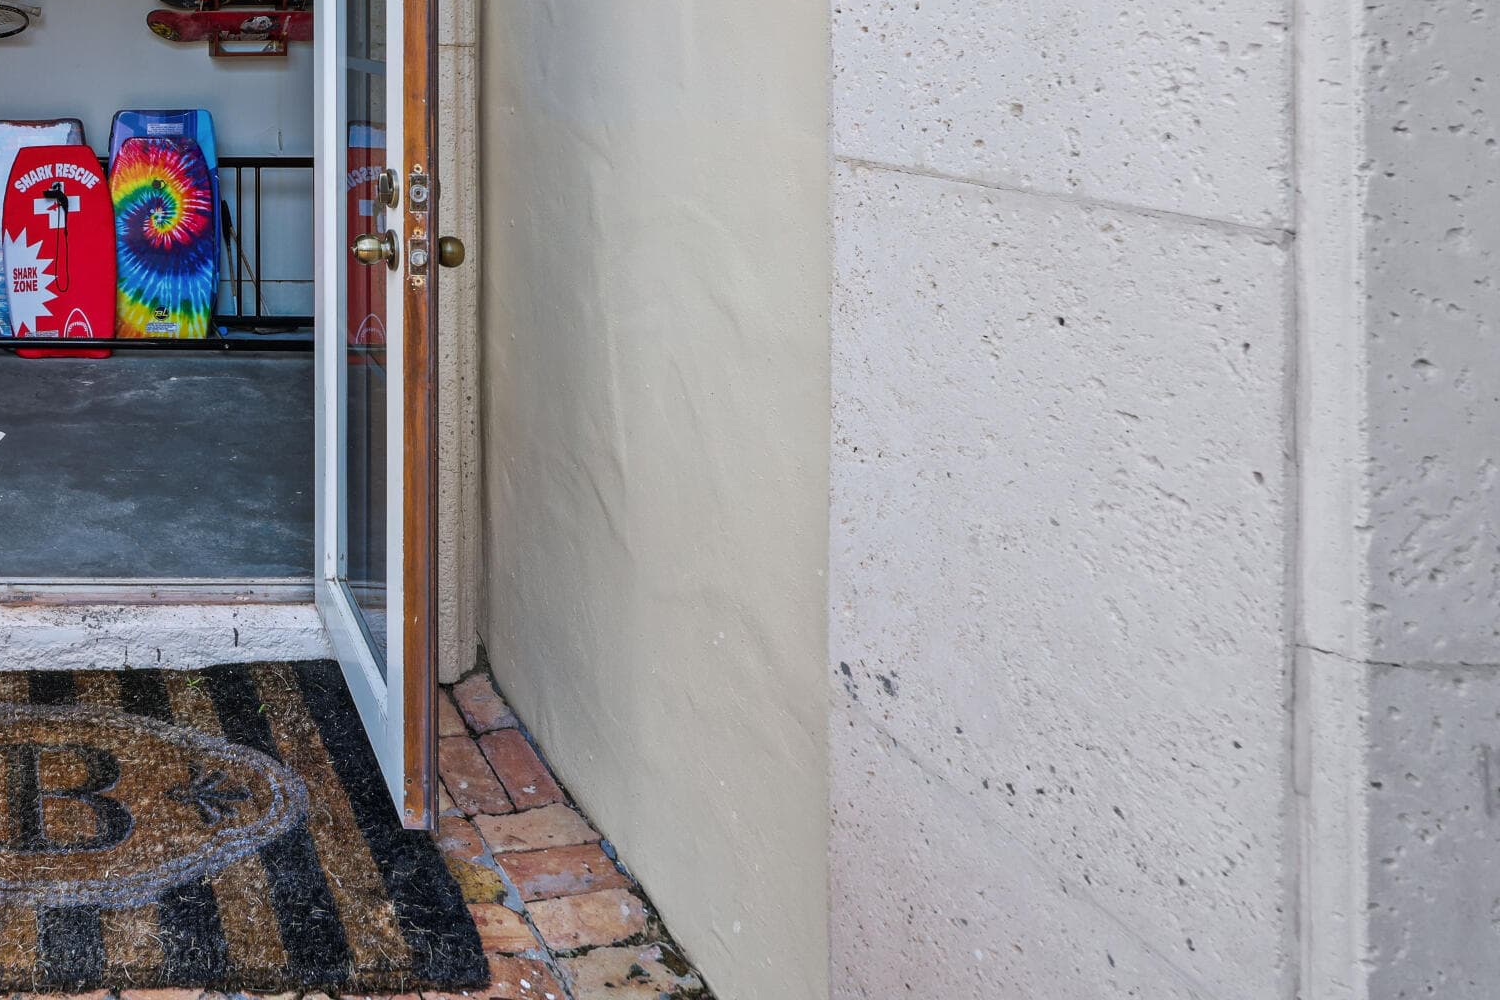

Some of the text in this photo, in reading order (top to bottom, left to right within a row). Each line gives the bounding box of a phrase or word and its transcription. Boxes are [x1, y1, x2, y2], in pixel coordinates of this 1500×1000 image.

[14, 163, 100, 193] SHARK RESCUE
[13, 267, 38, 280] SHARK
[13, 280, 38, 293] ZONE
